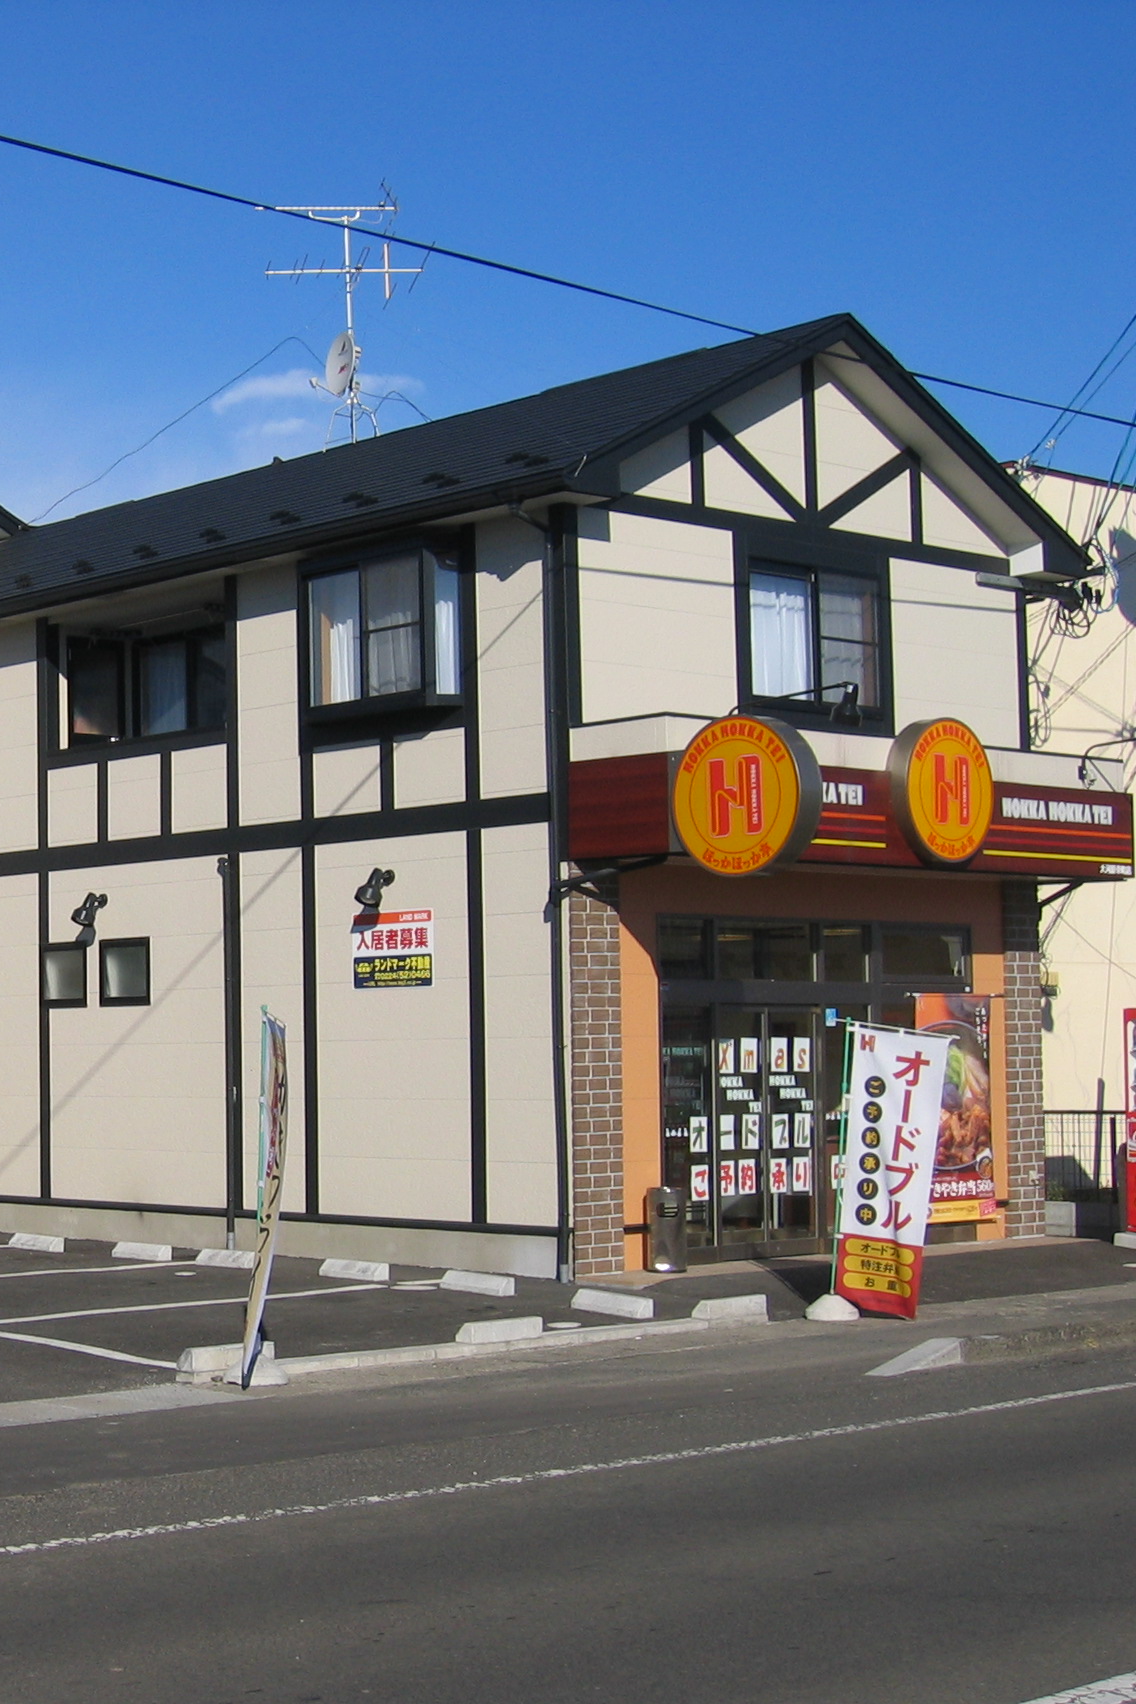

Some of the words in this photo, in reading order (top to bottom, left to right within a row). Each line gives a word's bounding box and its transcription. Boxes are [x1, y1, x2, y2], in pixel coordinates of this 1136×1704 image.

[683, 730, 719, 774] HOKKA
[720, 723, 764, 743] HOKKA
[765, 737, 787, 764] TEI
[914, 727, 939, 762] HOKKA
[942, 724, 971, 745] HOKKA
[971, 744, 986, 769] TEI
[838, 784, 863, 806] TEI
[1002, 797, 1047, 820] HOKKA
[1048, 801, 1092, 823] HOKKA
[1092, 804, 1113, 825] TEI
[702, 842, 773, 870] ほっかほっか亭
[927, 832, 976, 857] ほっかほっか亭
[356, 927, 428, 950] 入居者募集
[719, 1076, 744, 1088] OKKA
[858, 1078, 884, 1224] ご予約承り中
[881, 1051, 930, 1231] オードブル
[931, 1180, 976, 1198] きやき弁当
